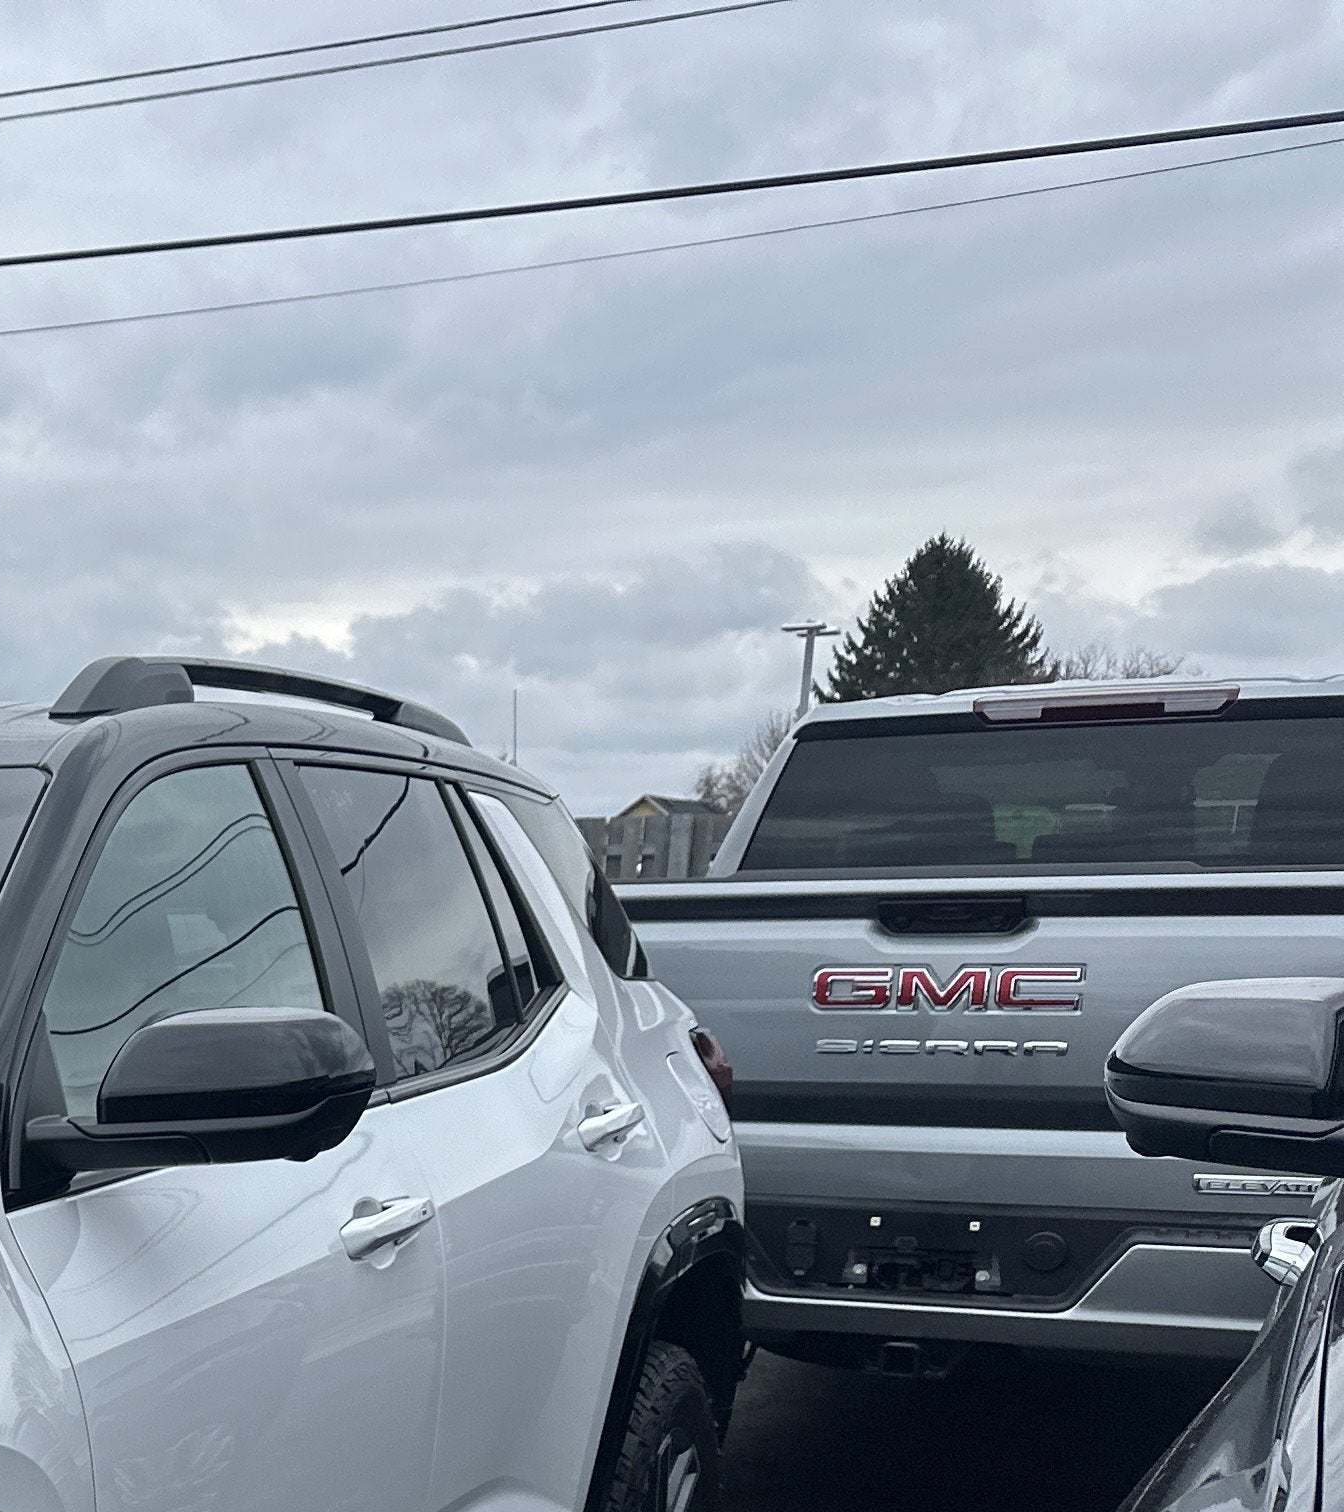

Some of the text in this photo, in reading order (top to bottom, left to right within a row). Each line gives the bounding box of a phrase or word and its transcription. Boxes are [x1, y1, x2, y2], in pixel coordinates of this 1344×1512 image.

[811, 963, 1086, 1014] GMC
[815, 1039, 1069, 1057] SIERRA
[1206, 1179, 1318, 1193] ELEVATI
